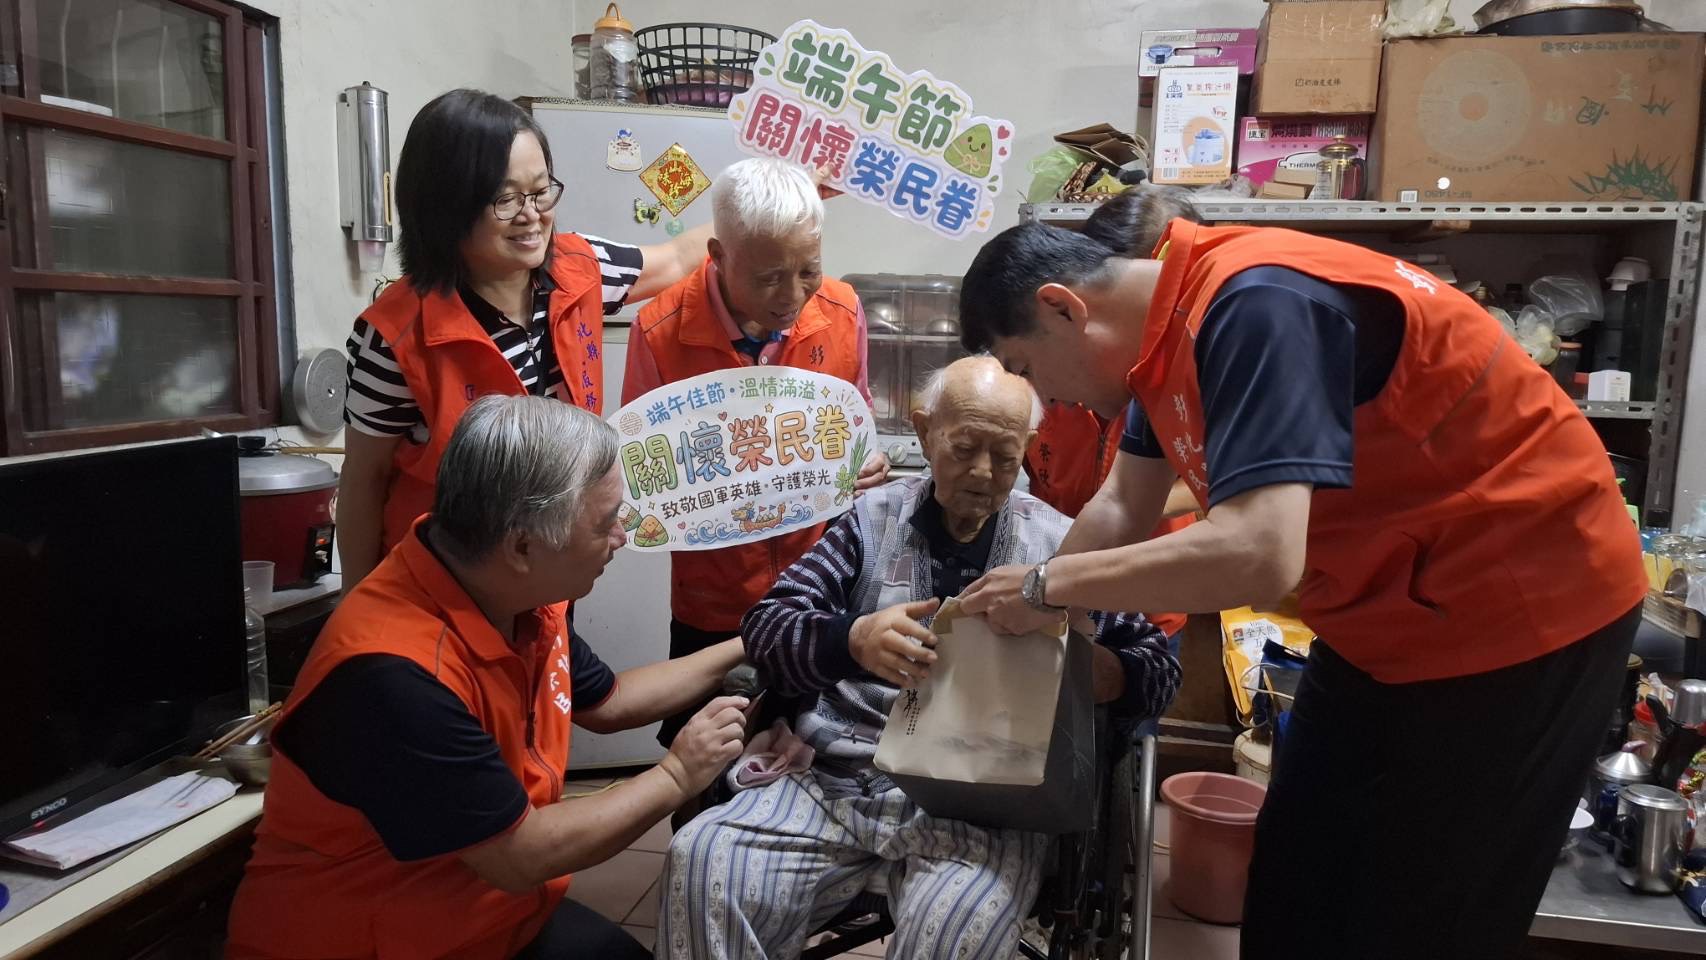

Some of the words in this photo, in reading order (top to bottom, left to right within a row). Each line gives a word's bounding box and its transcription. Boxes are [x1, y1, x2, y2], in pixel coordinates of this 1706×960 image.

[783, 31, 961, 150] 端午節
[745, 93, 977, 231] 關懷榮民眷
[620, 404, 852, 500] 關懷榮民眷
[31, 797, 68, 820] SYNCO
